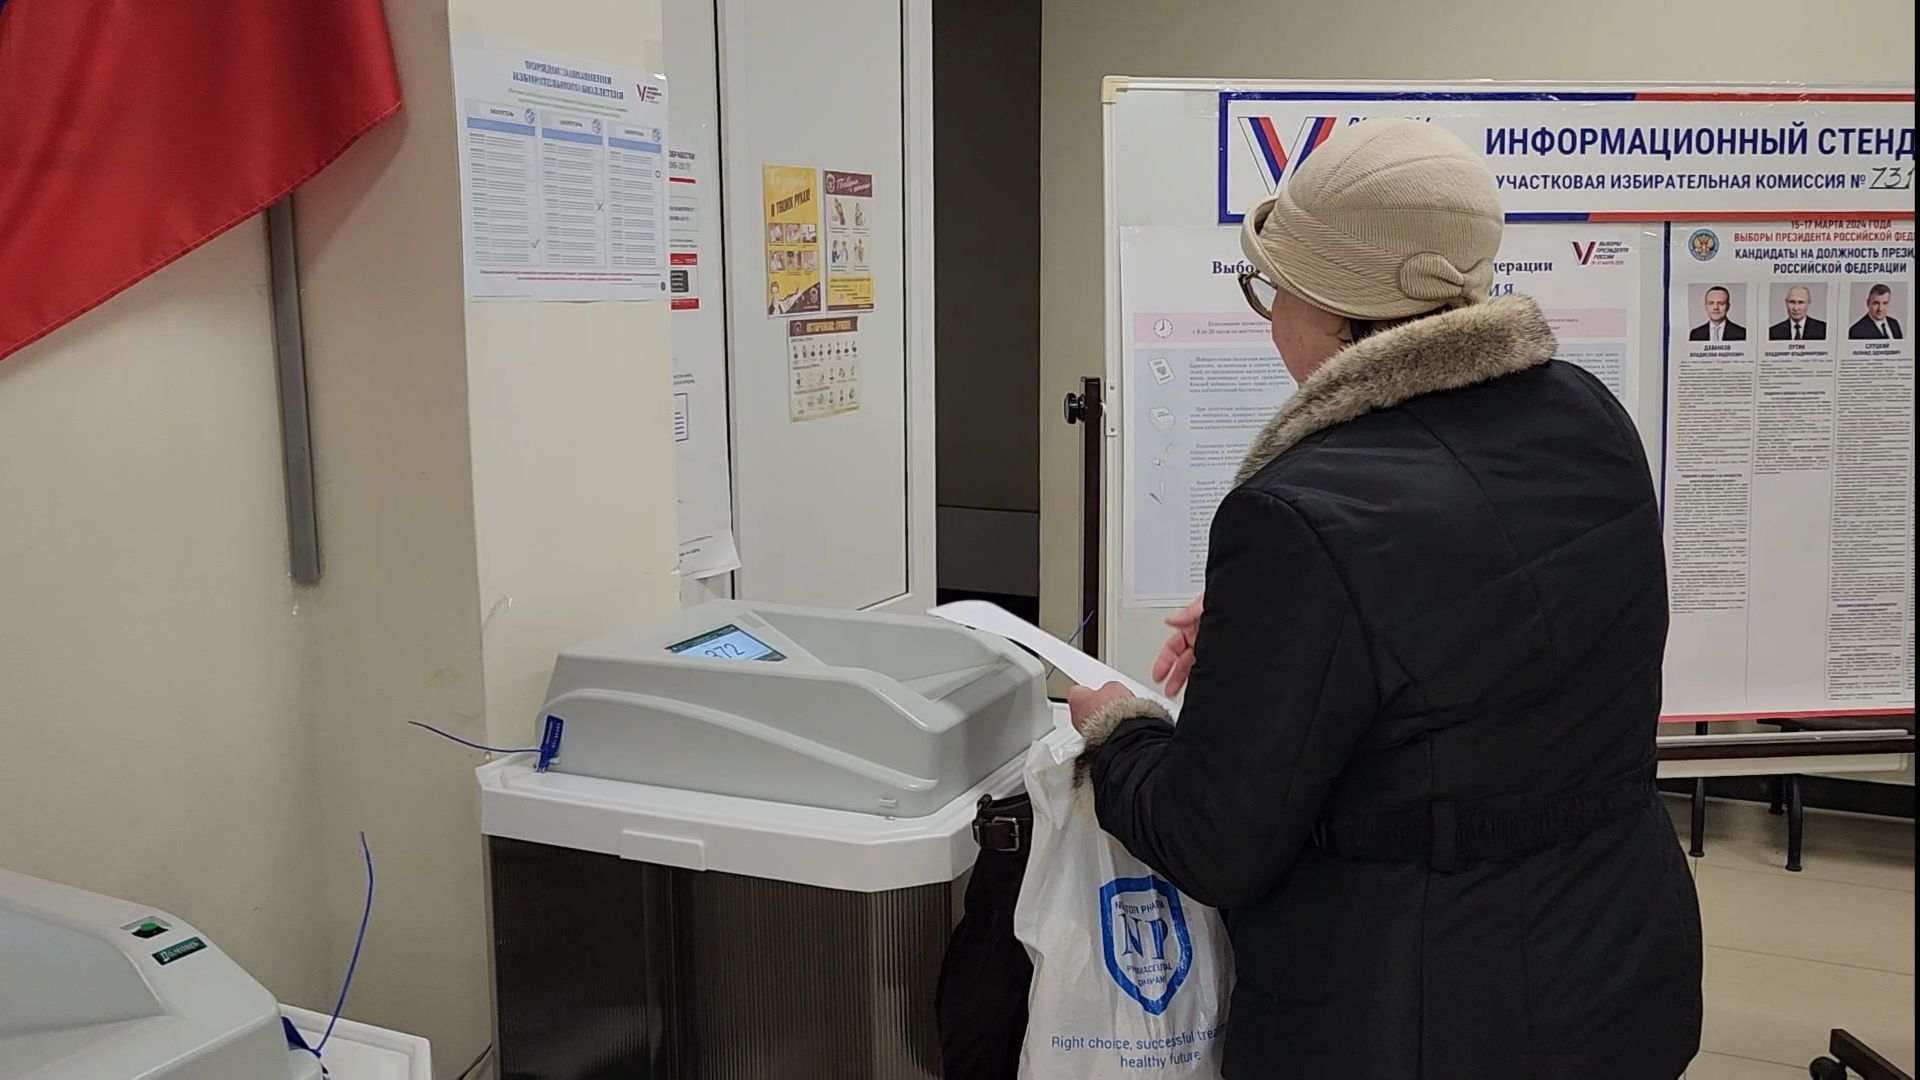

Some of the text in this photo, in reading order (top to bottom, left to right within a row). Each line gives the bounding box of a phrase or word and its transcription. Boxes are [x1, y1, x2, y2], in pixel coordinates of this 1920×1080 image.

[1486, 121, 1915, 161] ИНФОРМАЦИОННЫЙ СТЕНД
[1496, 173, 1866, 190] УЧАСТКОВАЯ ИЗБИРАТЕЛЬНАЯ КОМИССИЯ №
[1815, 220, 1844, 229] МАРТА
[1846, 220, 1866, 229] 2024
[1868, 220, 1891, 229] ГОДА
[1734, 230, 1915, 242] ВЫБОРЫ ПРЕЗИДЕНТА РОССИЙСКОЙ ФЕД
[1735, 247, 1915, 260] КАНДИДАТЫ НА ДОЛЖНОСТЬ ПРЕЗИ
[1212, 260, 1255, 274] Выбо
[1773, 261, 1907, 275] РОССИЙСКОЙ ФЕДЕРАЦИИ
[1052, 1035, 1084, 1051] Right
[1088, 1036, 1133, 1051] choice,
[1136, 1031, 1195, 1050] successful
[1120, 1050, 1201, 1070] healthy future
